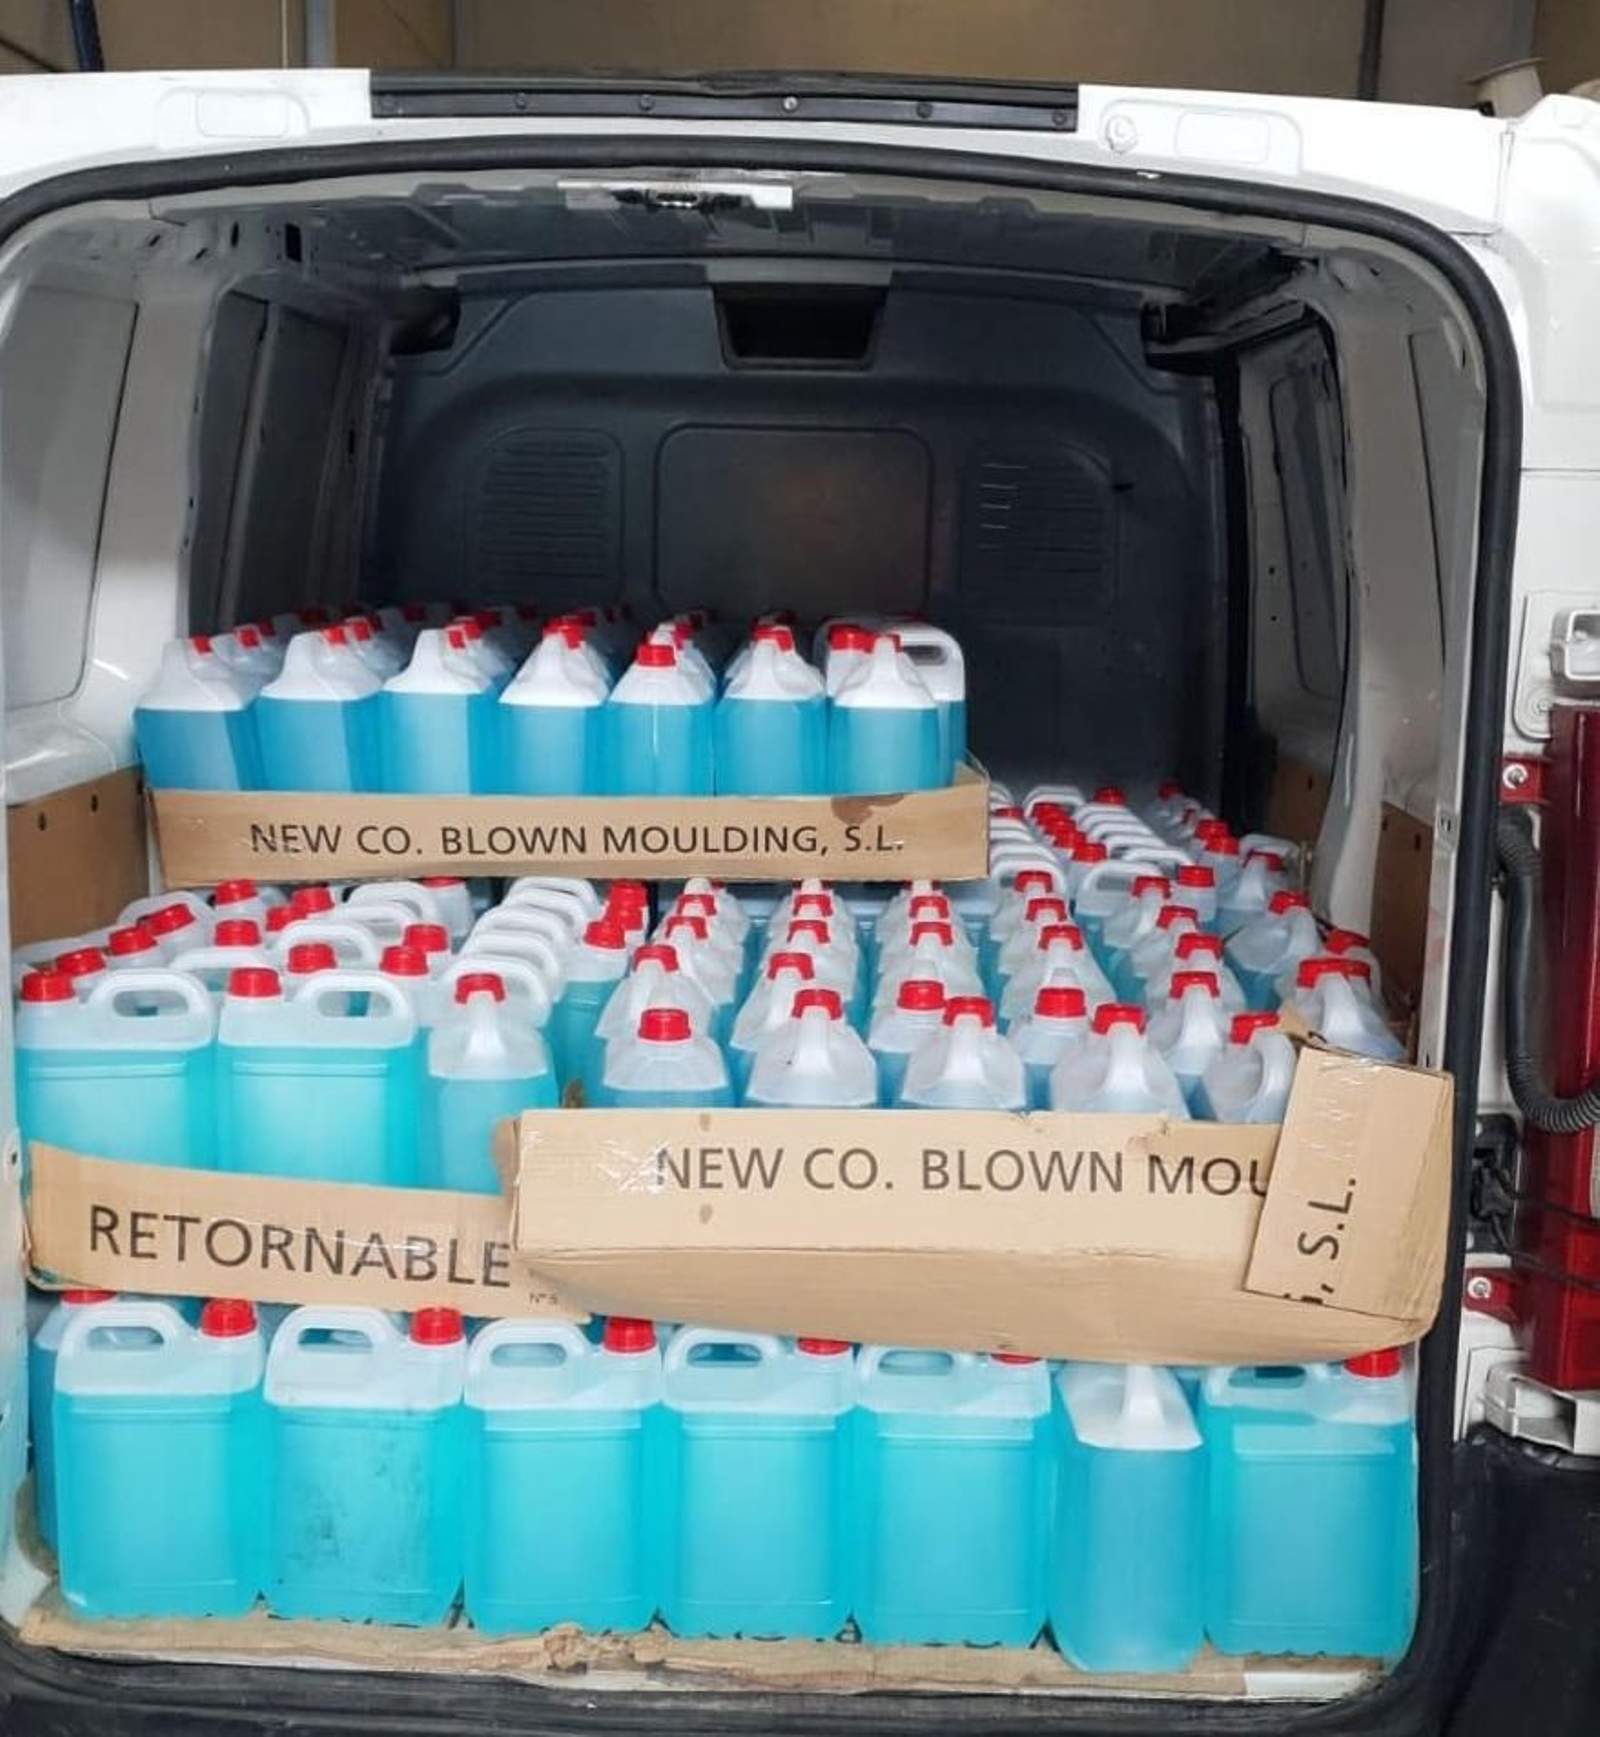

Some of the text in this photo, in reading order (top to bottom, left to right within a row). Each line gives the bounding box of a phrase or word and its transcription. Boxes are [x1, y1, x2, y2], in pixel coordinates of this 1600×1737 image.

[249, 823, 903, 857] NEW CO. BLOWN MOULDING, S.L.
[655, 1147, 785, 1191] NEW
[803, 1147, 894, 1191] CO.
[922, 1148, 1123, 1193] BLOWN
[90, 1204, 511, 1289] RETORNABLE
